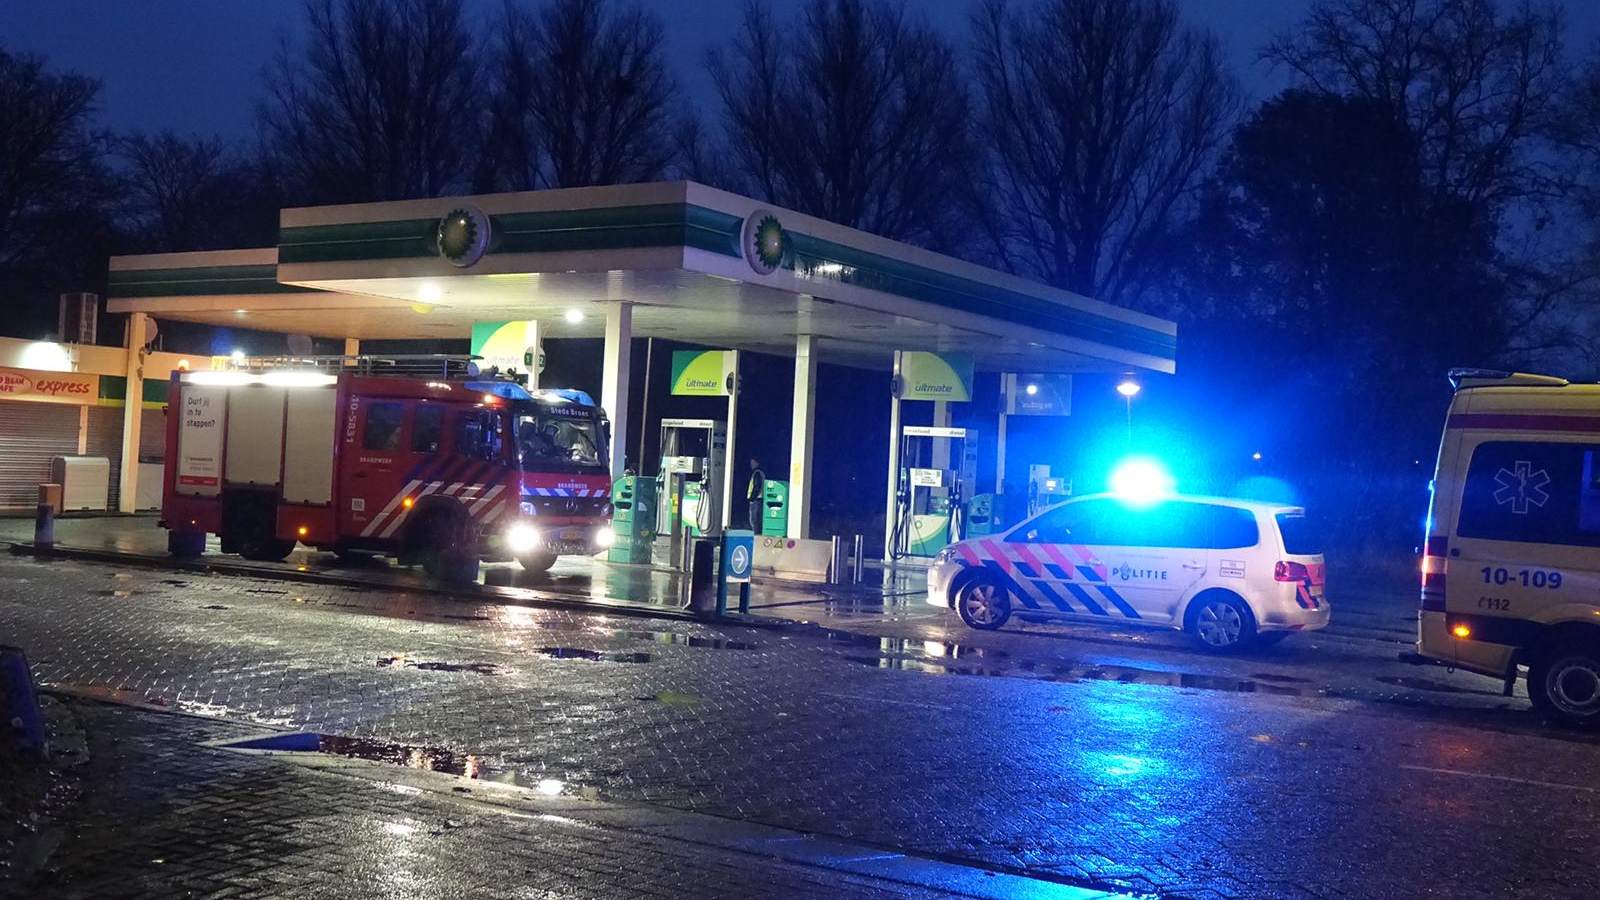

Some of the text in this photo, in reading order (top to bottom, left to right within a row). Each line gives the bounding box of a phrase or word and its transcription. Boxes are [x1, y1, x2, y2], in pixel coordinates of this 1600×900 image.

[36, 380, 91, 396] express
[1112, 567, 1167, 581] POLITIE
[1481, 567, 1563, 589] 10-109
[1488, 598, 1510, 611] 112
